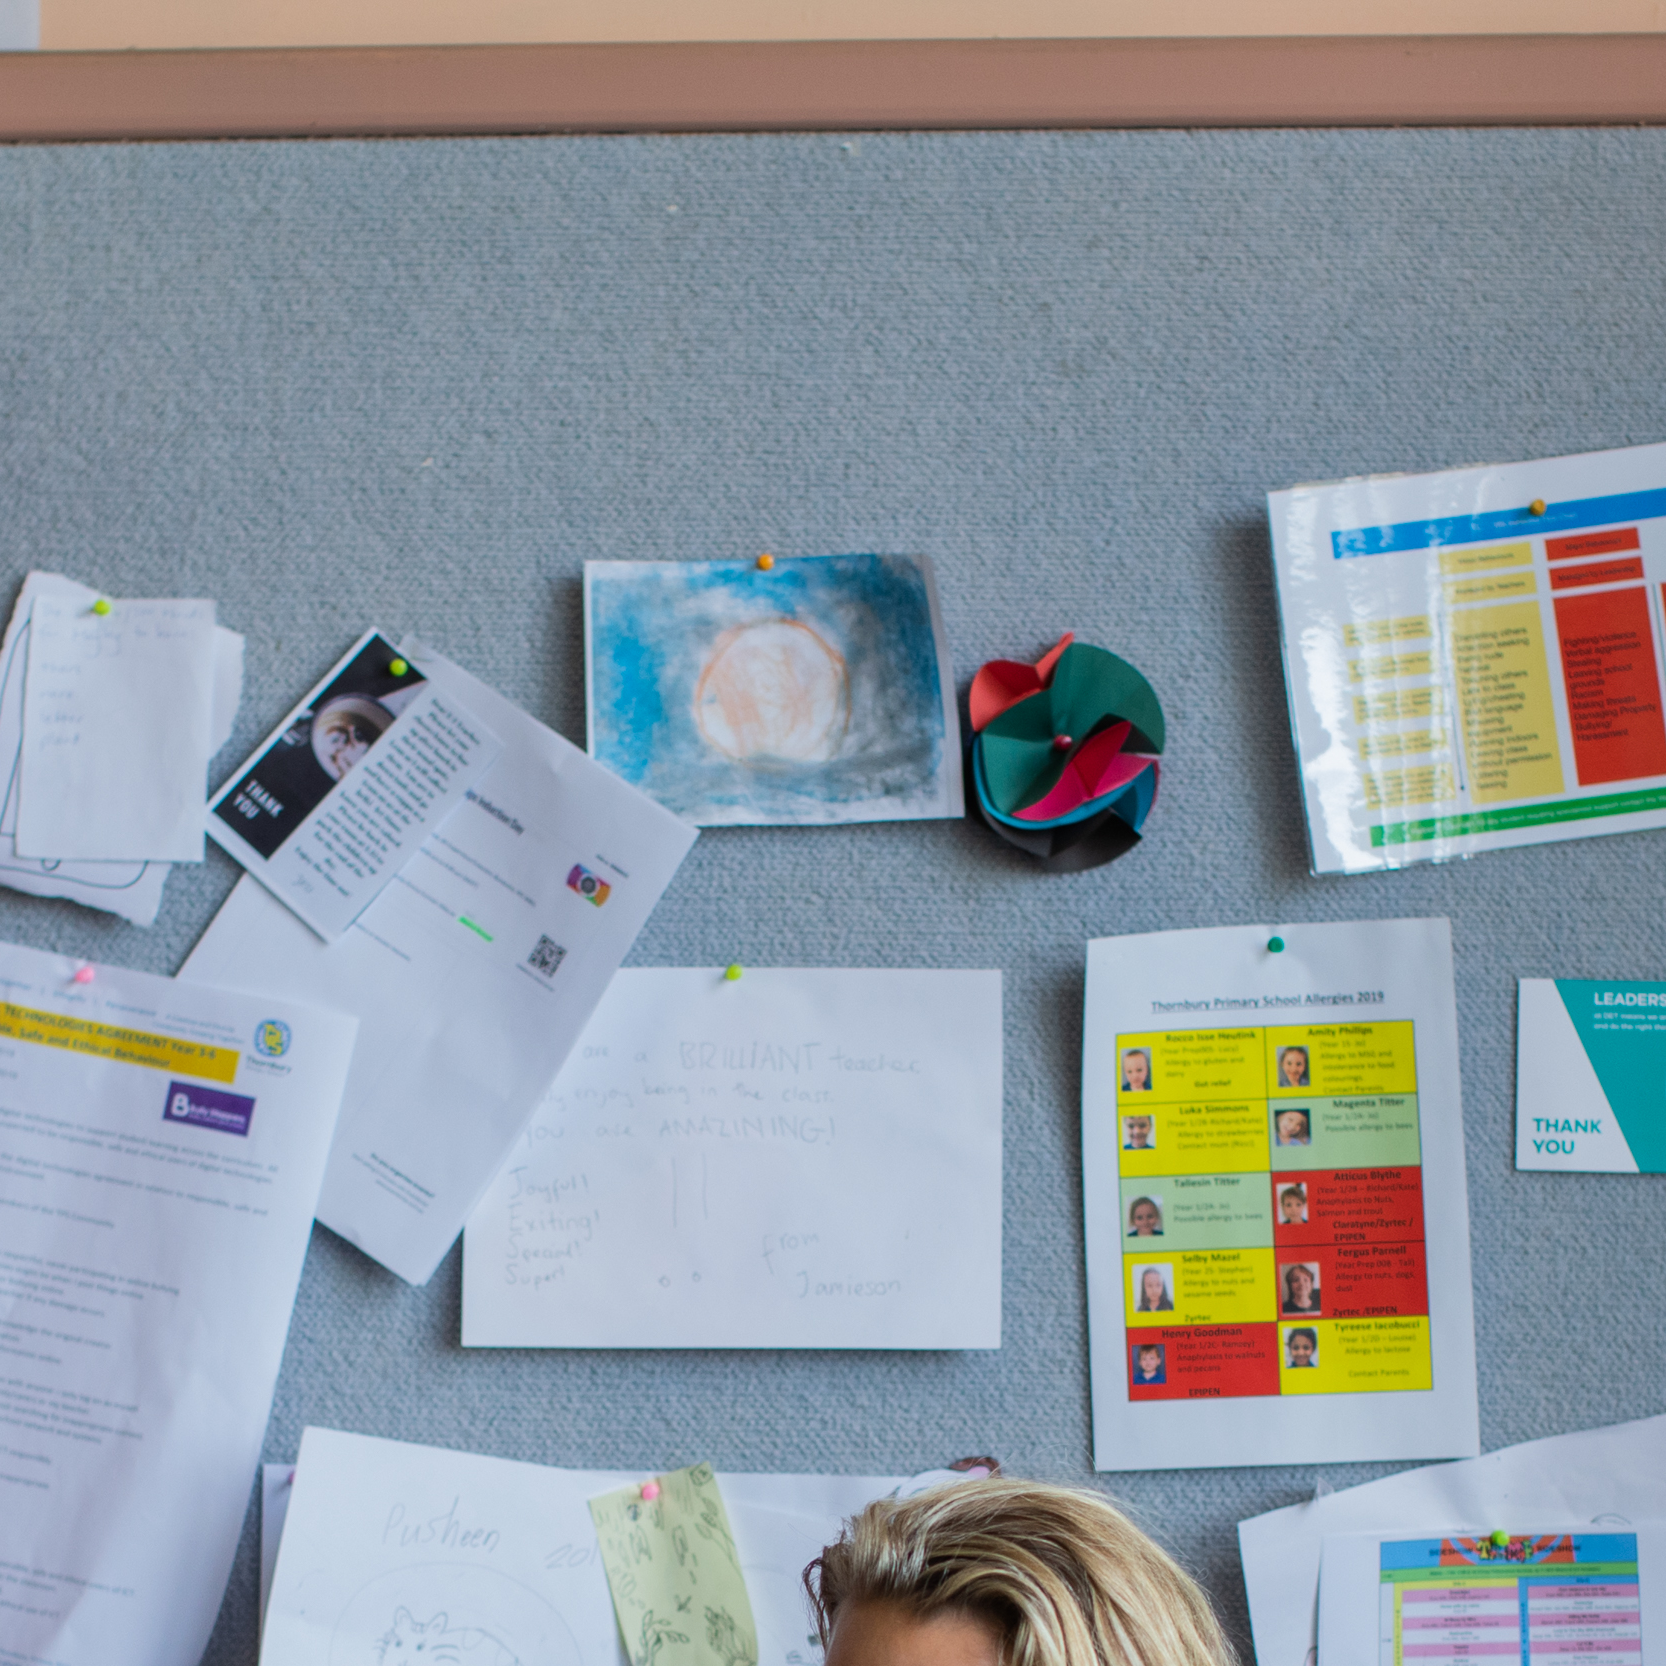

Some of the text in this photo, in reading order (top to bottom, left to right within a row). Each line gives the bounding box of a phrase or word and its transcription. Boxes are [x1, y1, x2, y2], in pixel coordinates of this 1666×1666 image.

[232, 792, 260, 821] YOU
[244, 778, 284, 819] THANK
[1151, 990, 1385, 1014] Thornbury Primary School Allergies 2019
[95, 1021, 168, 1049] AGREEMENT
[677, 1040, 823, 1075] BRILLIANT
[1532, 1117, 1602, 1134] THANK
[1532, 1139, 1575, 1155] YOU
[1161, 1326, 1242, 1341] Henry Goodman
[1188, 1386, 1221, 1397] EPIPEN
[382, 1496, 501, 1552] Pusheen
